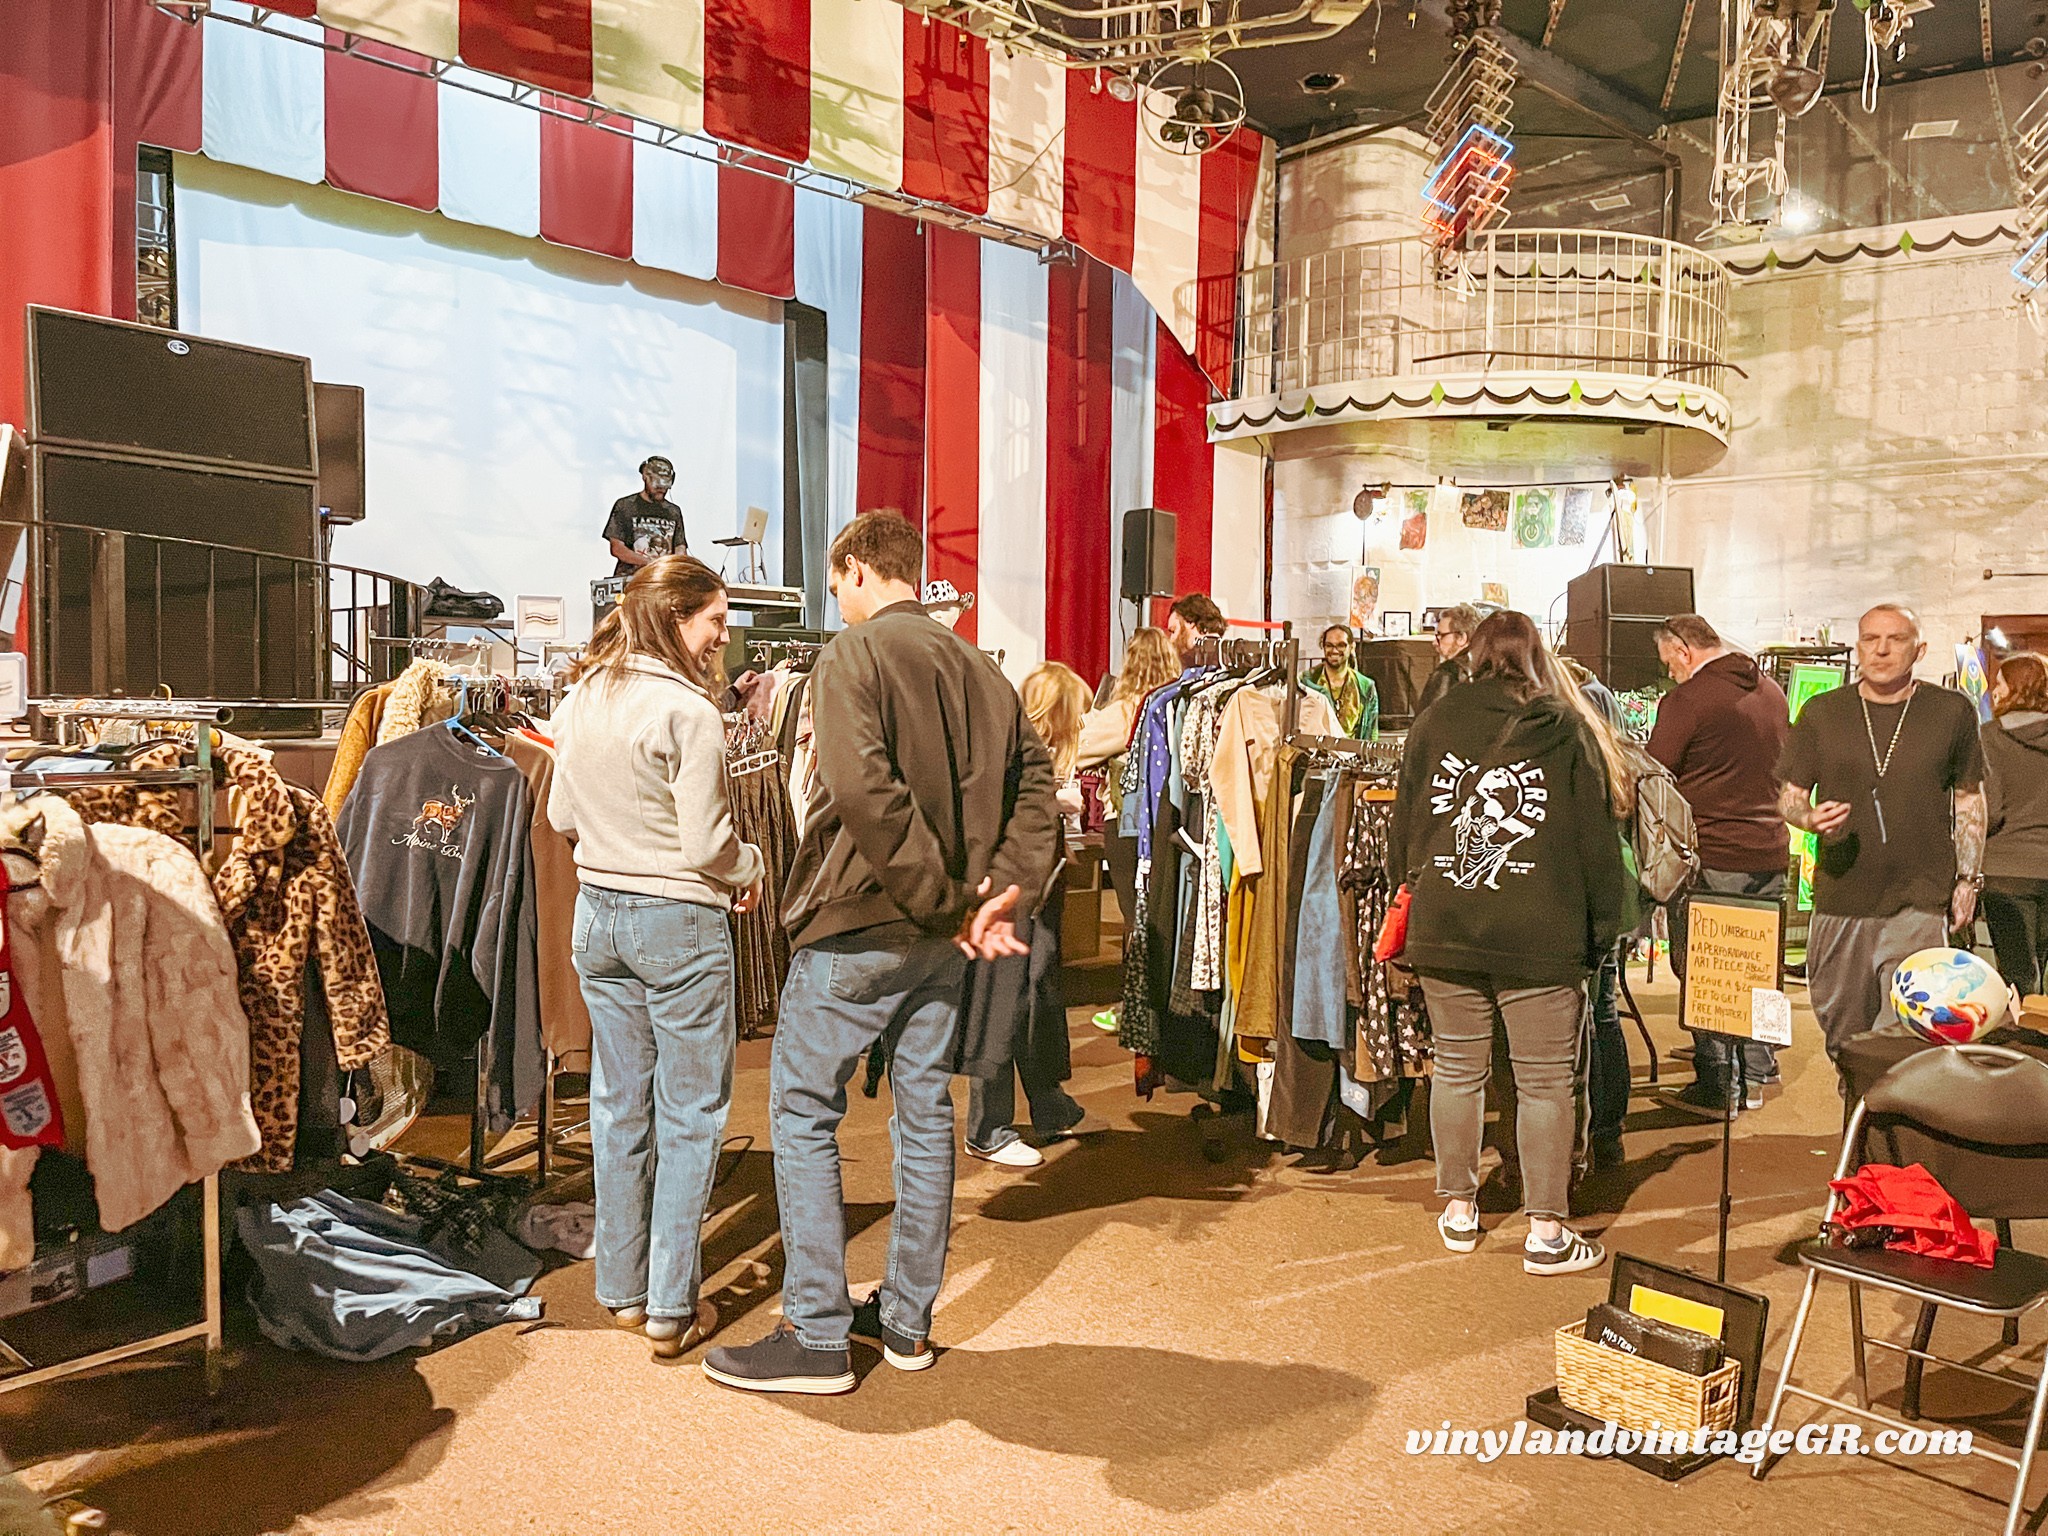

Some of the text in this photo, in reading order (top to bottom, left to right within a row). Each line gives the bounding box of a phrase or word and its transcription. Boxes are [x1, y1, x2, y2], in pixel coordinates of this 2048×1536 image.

[391, 829, 437, 850] Alpine
[1694, 956, 1709, 968] ART
[1713, 957, 1744, 971] PIECE
[1696, 976, 1722, 987] LEAVE
[1725, 980, 1731, 989] A
[1692, 986, 1738, 1005] TIP TO GET
[1691, 1000, 1747, 1021] FREE MYSTERY
